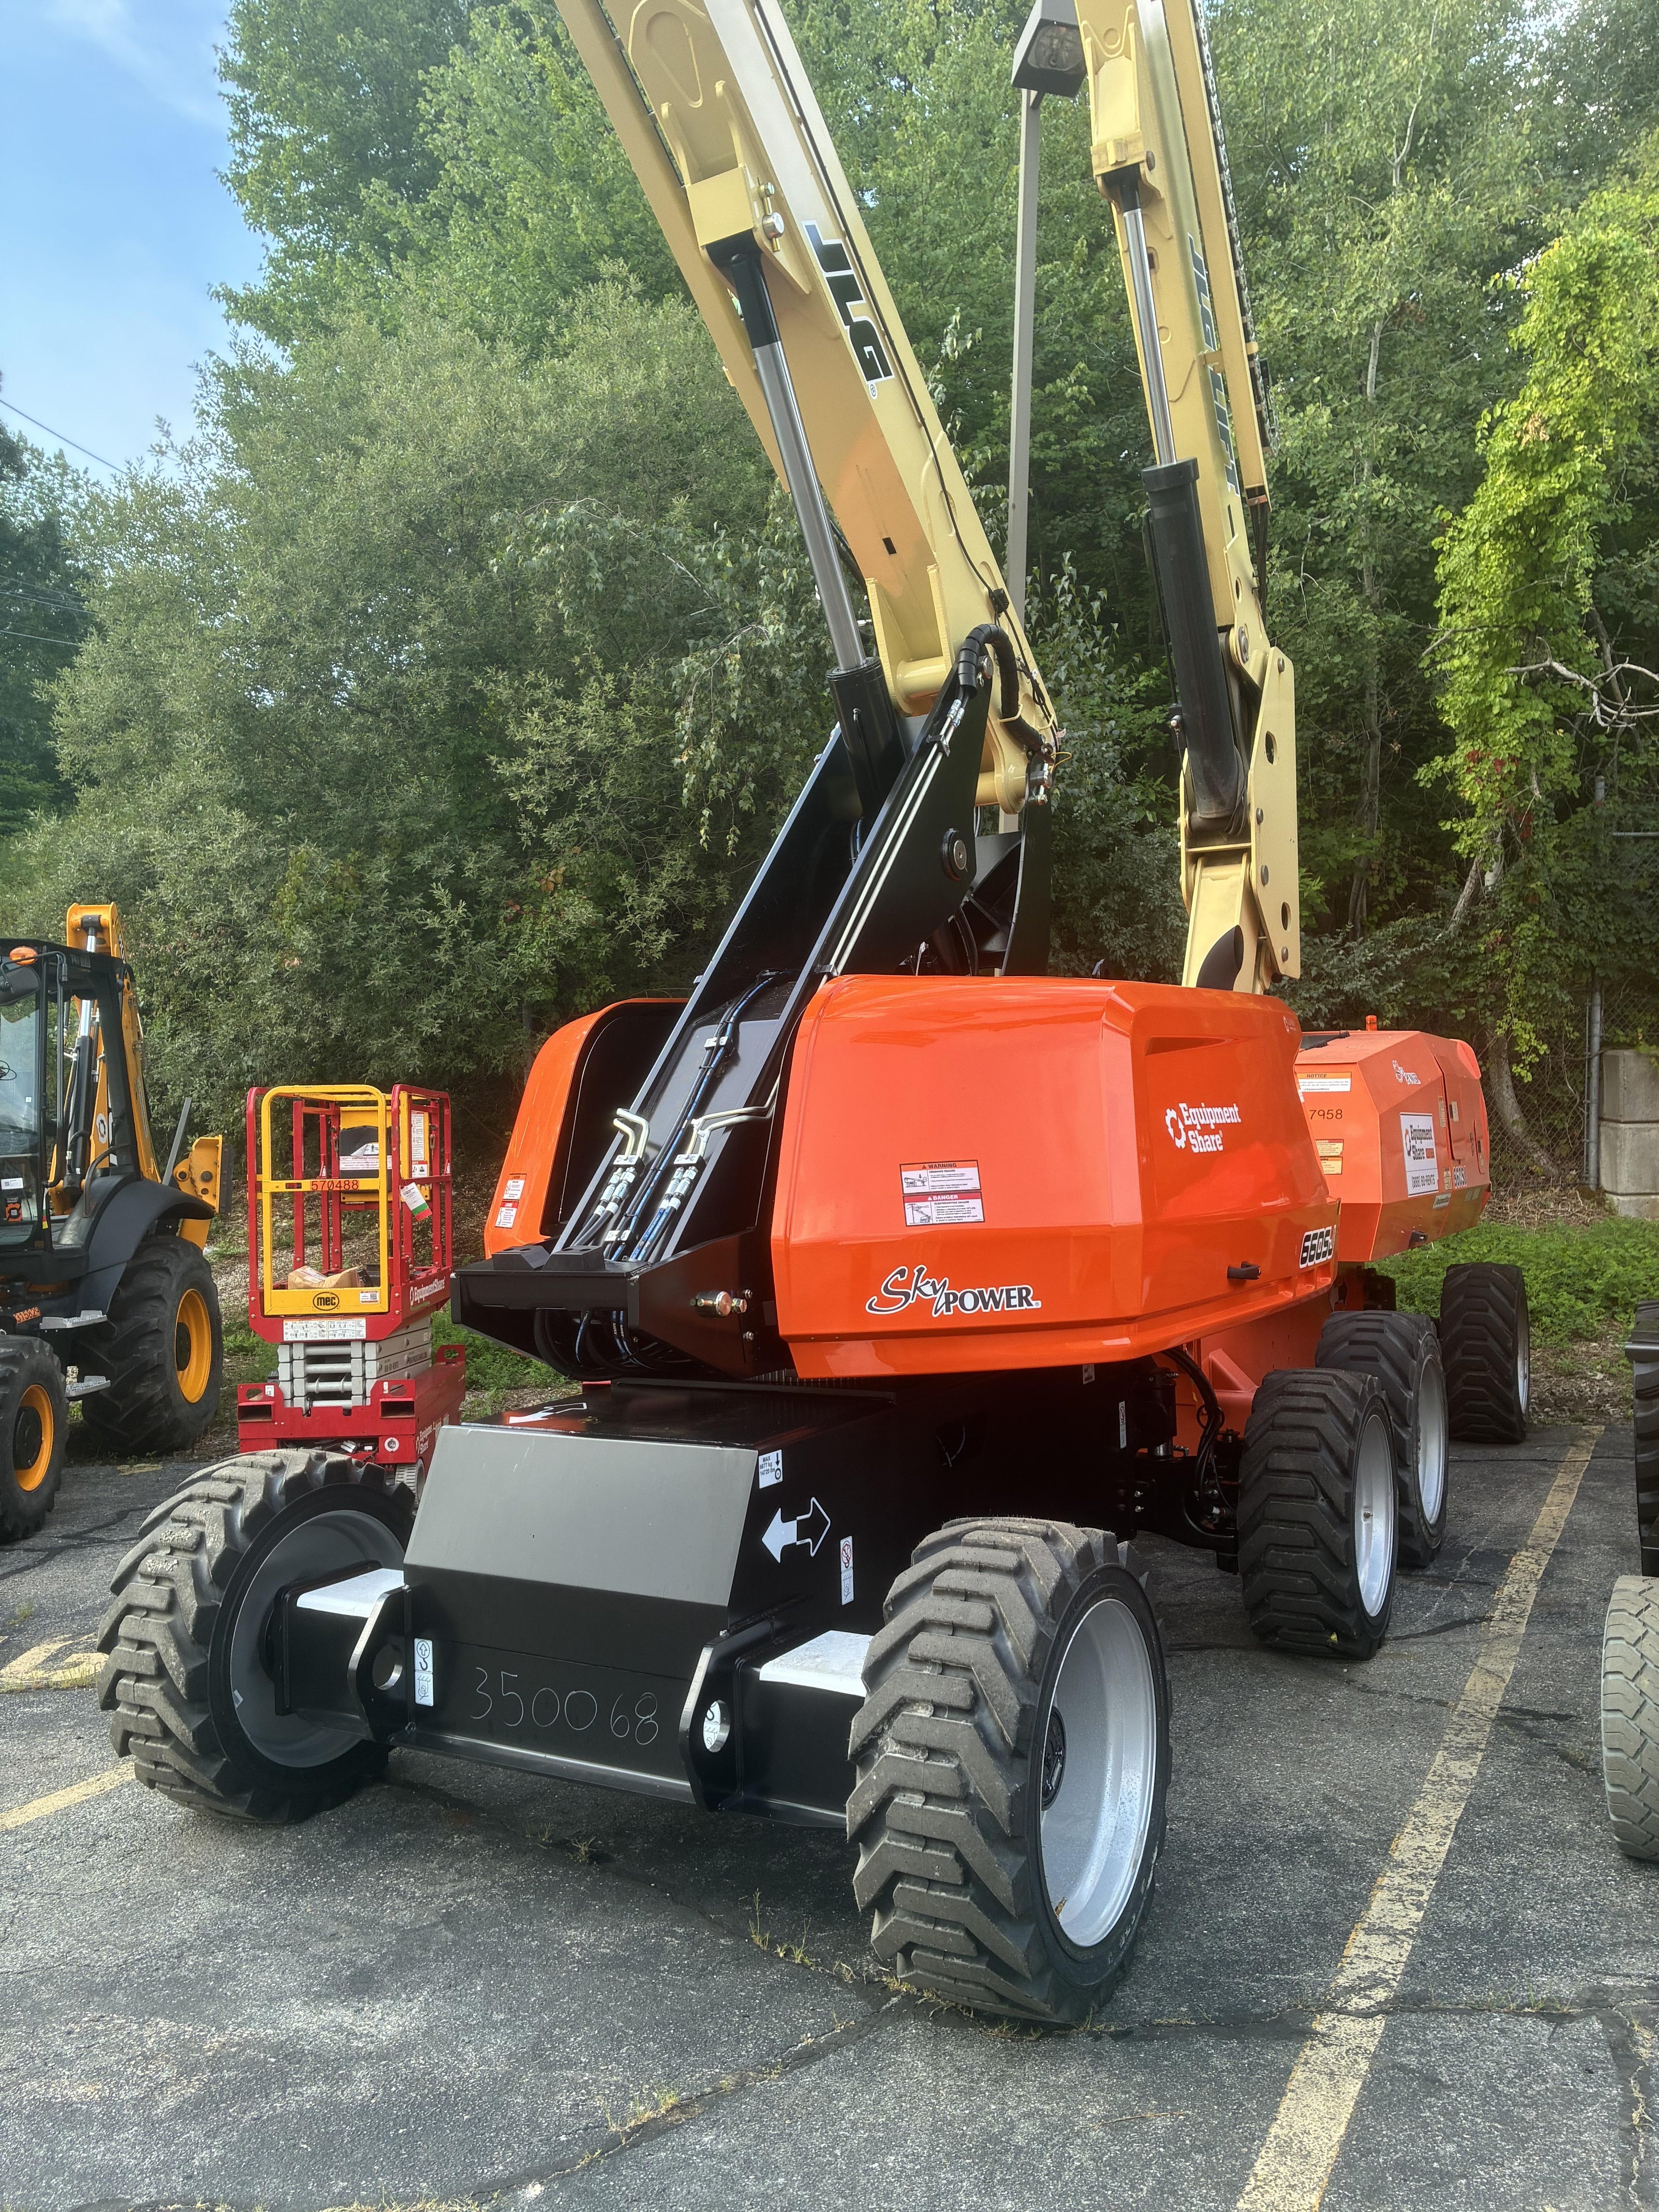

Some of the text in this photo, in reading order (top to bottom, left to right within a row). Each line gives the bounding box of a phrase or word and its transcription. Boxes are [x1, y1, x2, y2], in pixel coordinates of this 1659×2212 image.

[802, 220, 894, 384] JLG
[1188, 233, 1217, 351] JLG
[1178, 1102, 1241, 1130] Equipment
[1309, 1109, 1343, 1120] 7958
[1188, 1130, 1224, 1153] Share
[1410, 1124, 1433, 1144] Equipment
[1412, 1145, 1425, 1160] Share
[311, 1180, 358, 1190] 570488
[470, 1667, 659, 1745] 350068
